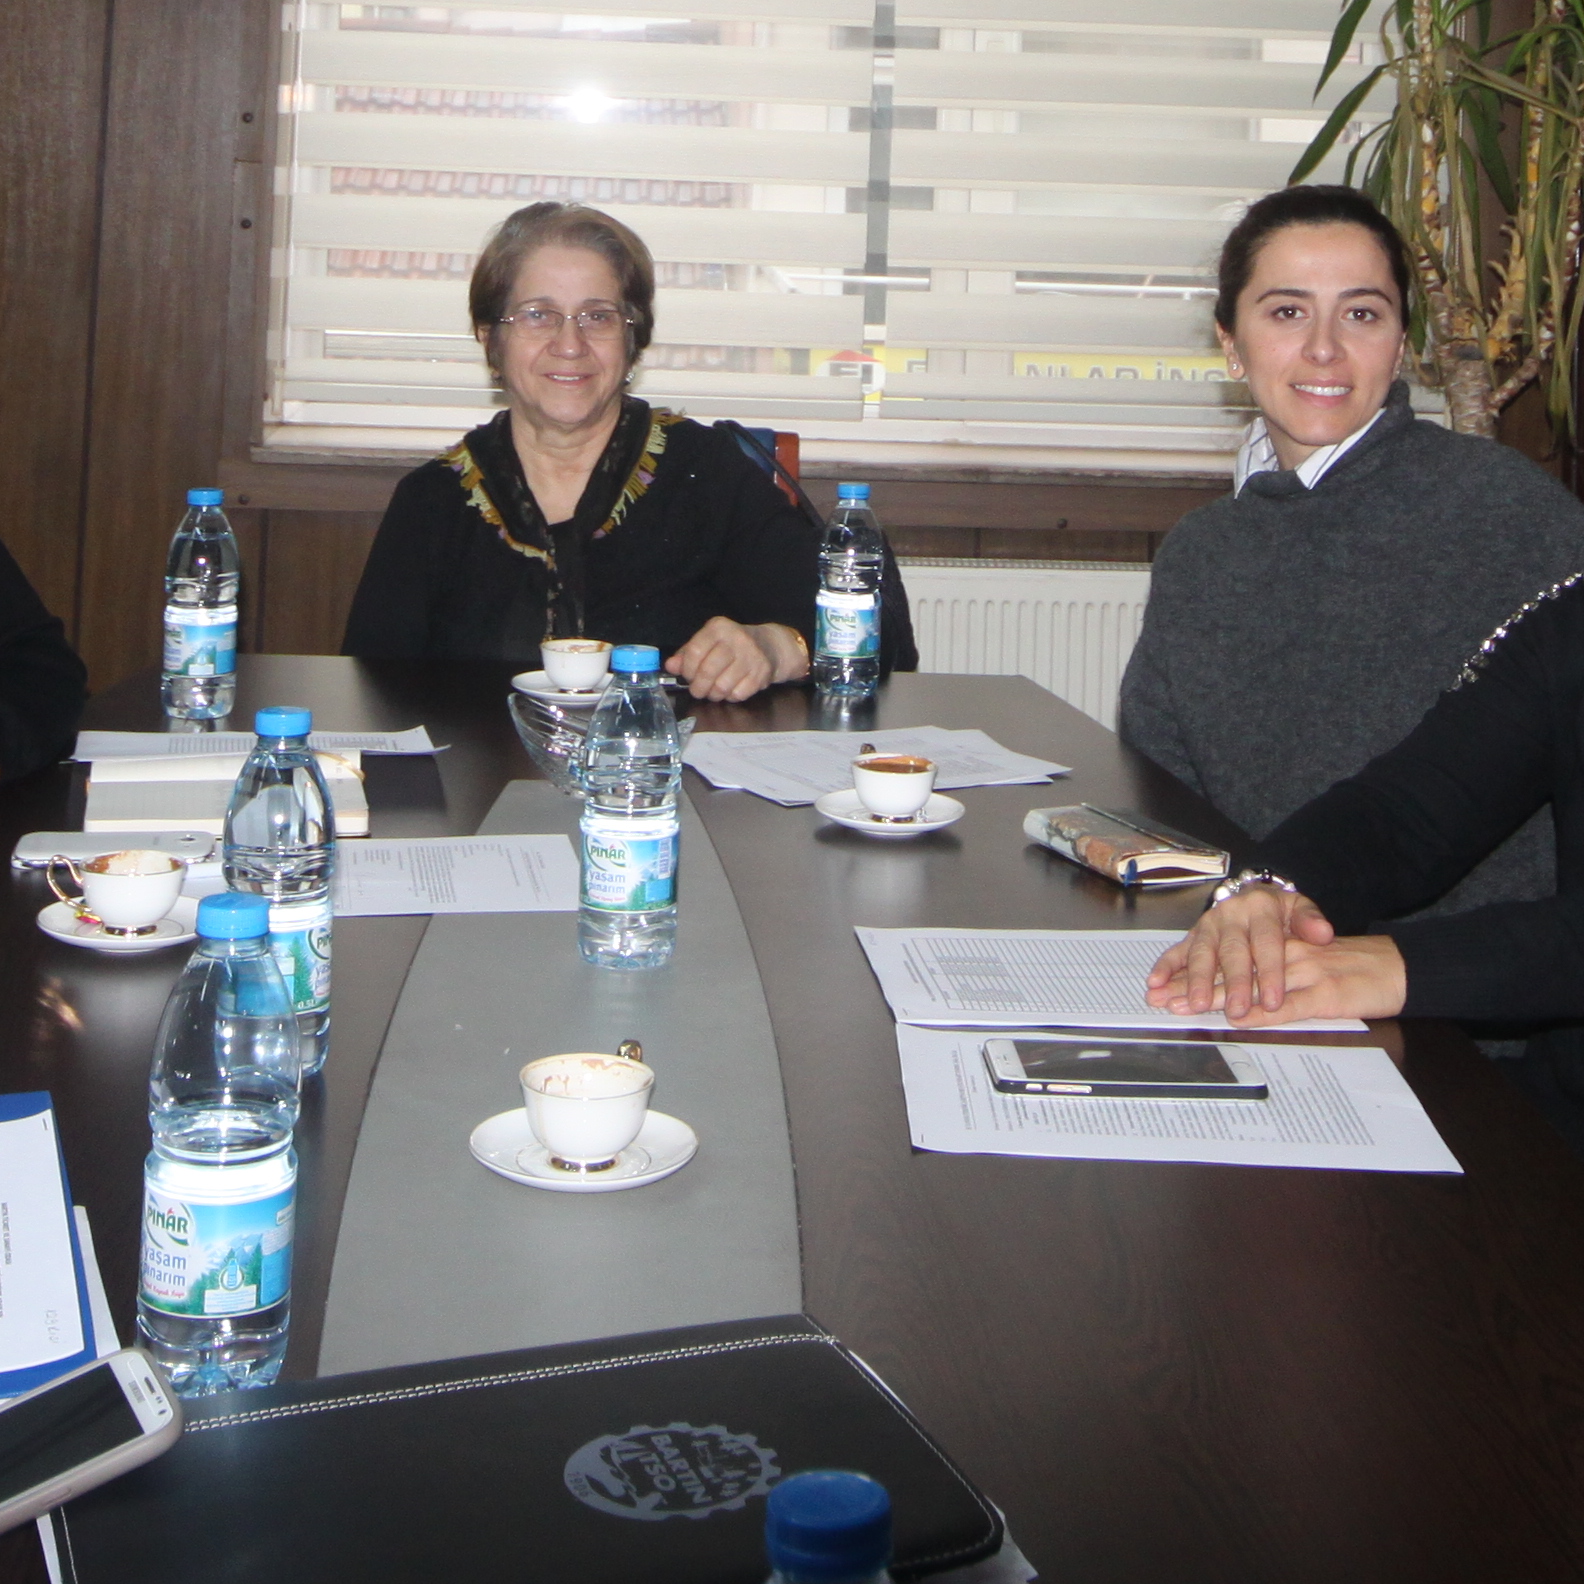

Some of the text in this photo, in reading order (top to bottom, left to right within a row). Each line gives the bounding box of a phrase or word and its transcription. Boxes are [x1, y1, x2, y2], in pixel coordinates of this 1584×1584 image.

[590, 845, 626, 859] PINAR
[147, 1205, 188, 1234] PINAR
[143, 1244, 186, 1270] yaşam
[639, 1453, 676, 1491] TSO
[651, 1434, 713, 1504] BARTIN
